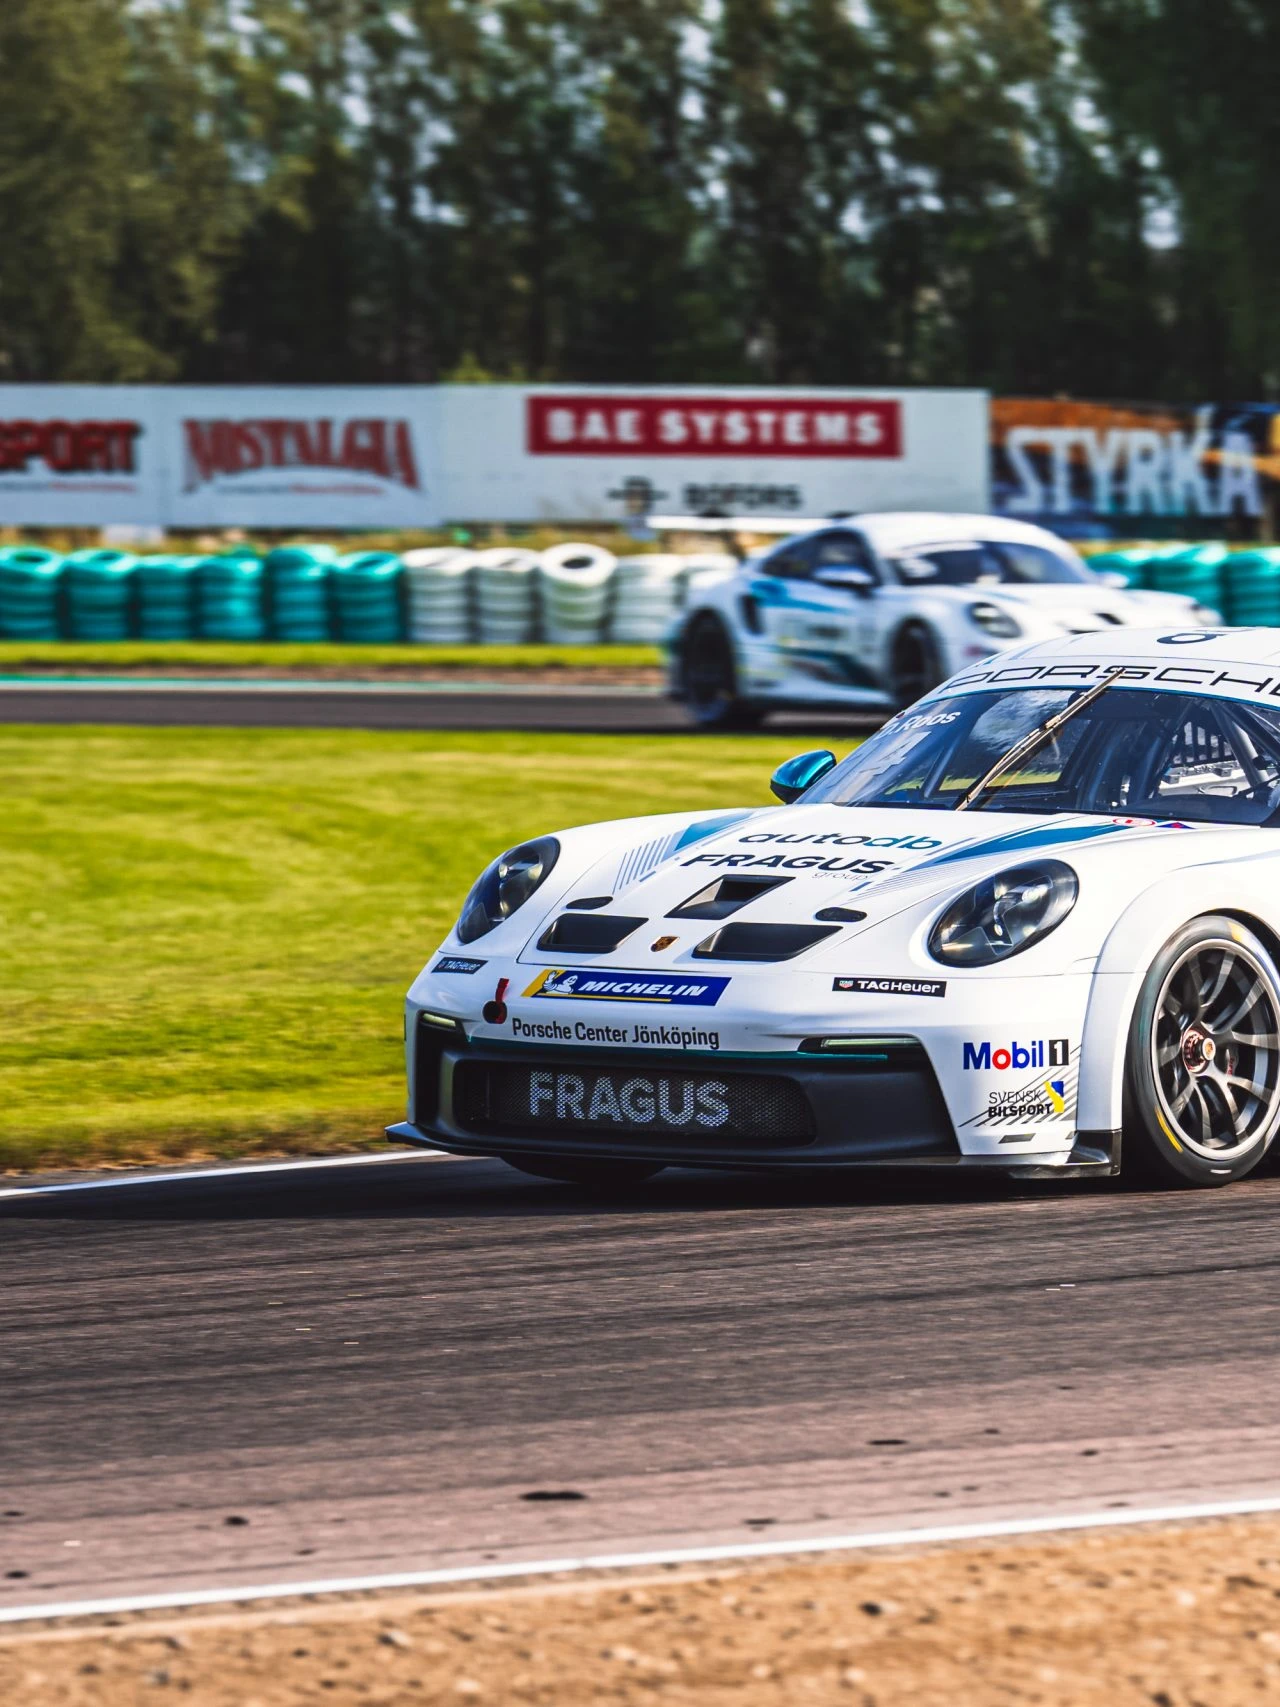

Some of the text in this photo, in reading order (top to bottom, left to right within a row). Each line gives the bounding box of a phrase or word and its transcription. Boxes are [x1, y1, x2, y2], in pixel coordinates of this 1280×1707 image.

[547, 408, 883, 446] BAE SYSTEMS
[738, 832, 943, 850] autodb
[680, 853, 894, 874] FRAGUS
[577, 981, 709, 997] MICHELIN
[511, 1017, 720, 1050] Porsche Center Jönköping
[963, 1040, 1044, 1070] Mobil
[529, 1071, 729, 1127] FRAGUS
[988, 1090, 1041, 1104] SVENSK
[988, 1103, 1053, 1118] BILSPORT
